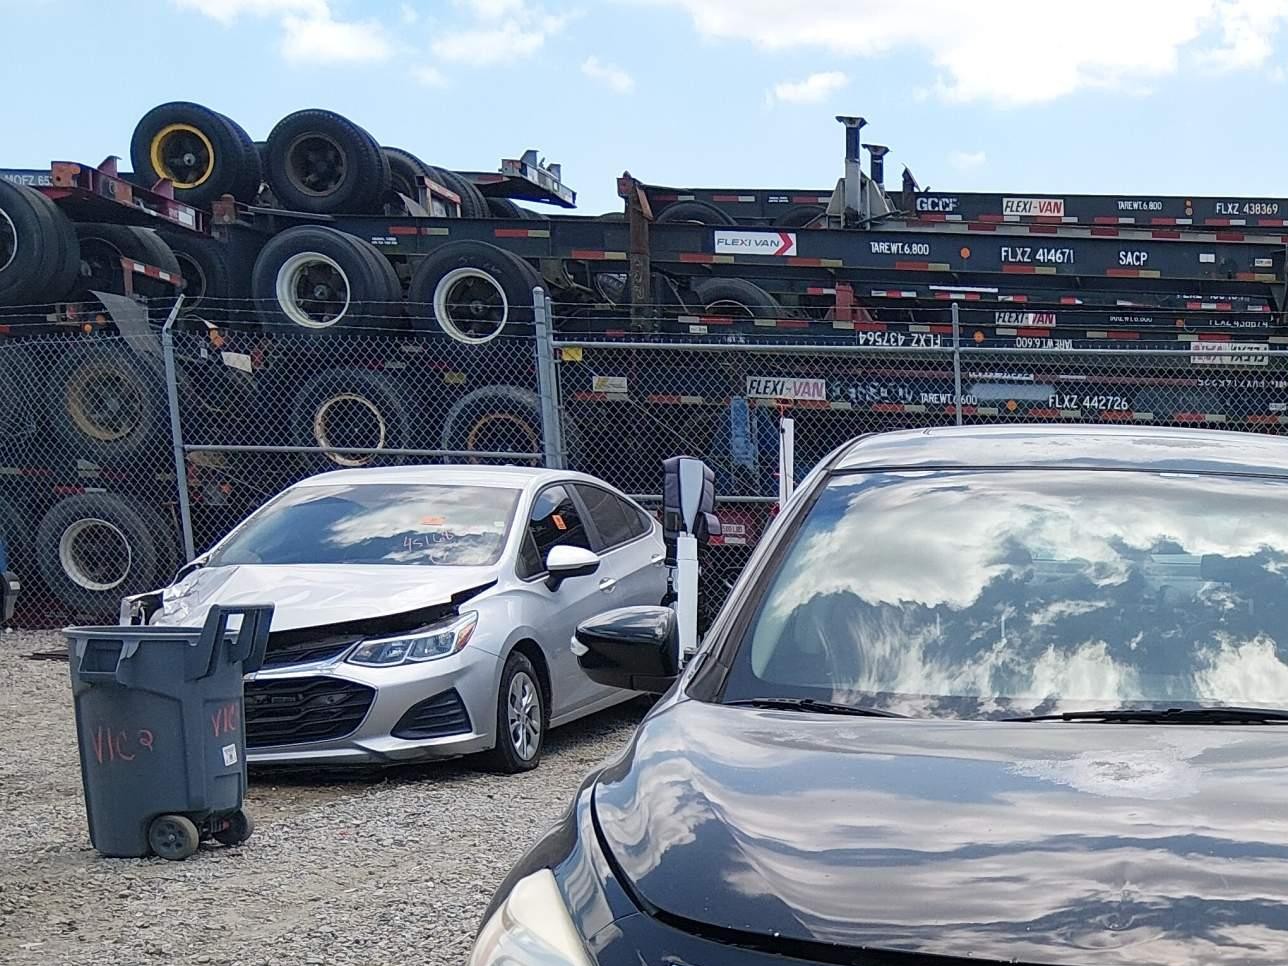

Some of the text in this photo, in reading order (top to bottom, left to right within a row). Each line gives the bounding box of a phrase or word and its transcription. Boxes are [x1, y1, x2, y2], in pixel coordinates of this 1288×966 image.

[1003, 200, 1062, 214] FLEXI-VAN
[1216, 202, 1279, 215] FLXZ 438369
[1001, 247, 1074, 264] FLXZ 414671
[1119, 251, 1148, 266] SACP
[859, 331, 905, 346] 437564
[1048, 394, 1128, 410] FLXZ 442726
